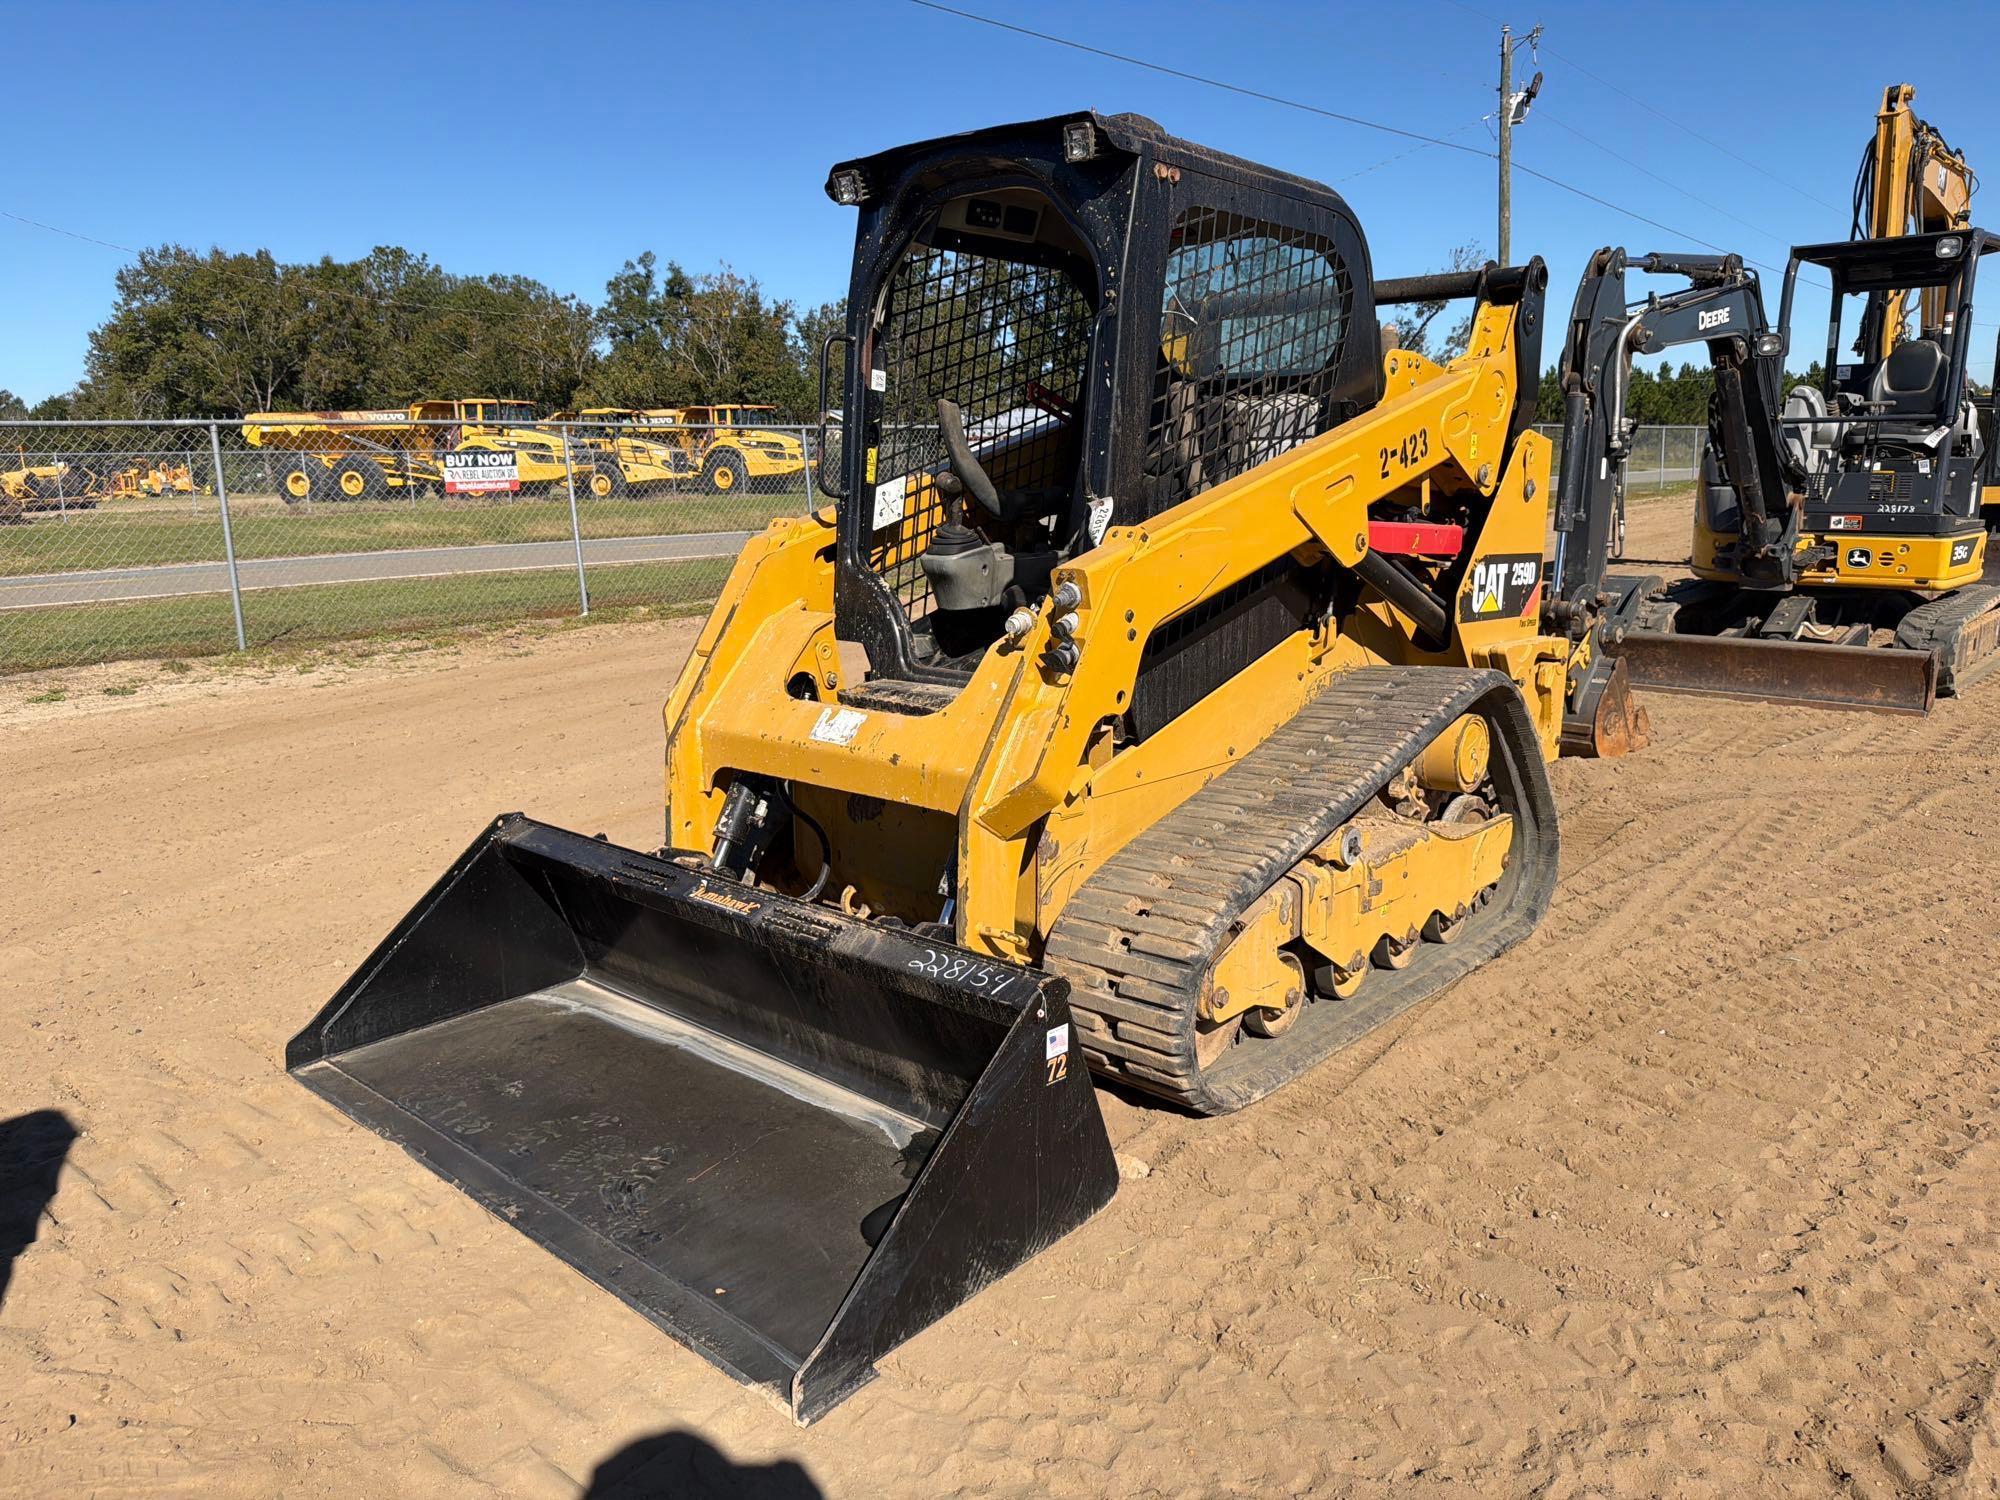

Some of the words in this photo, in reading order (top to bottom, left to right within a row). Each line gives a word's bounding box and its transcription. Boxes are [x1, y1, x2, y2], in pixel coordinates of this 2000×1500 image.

[1698, 306, 1730, 331] DEERE
[367, 413, 406, 421] VOLVO
[445, 454, 474, 467] BUY
[477, 453, 513, 467] NOW
[1379, 427, 1428, 480] 2-423
[462, 469, 480, 480] REBEL
[481, 468, 506, 480] AUCTION
[1877, 504, 1916, 514] 228178
[1952, 545, 1969, 561] 35G
[1472, 562, 1509, 614] CAT
[1511, 561, 1537, 586] 259D
[908, 949, 1016, 995] 228154
[1047, 1054, 1067, 1082] 72
